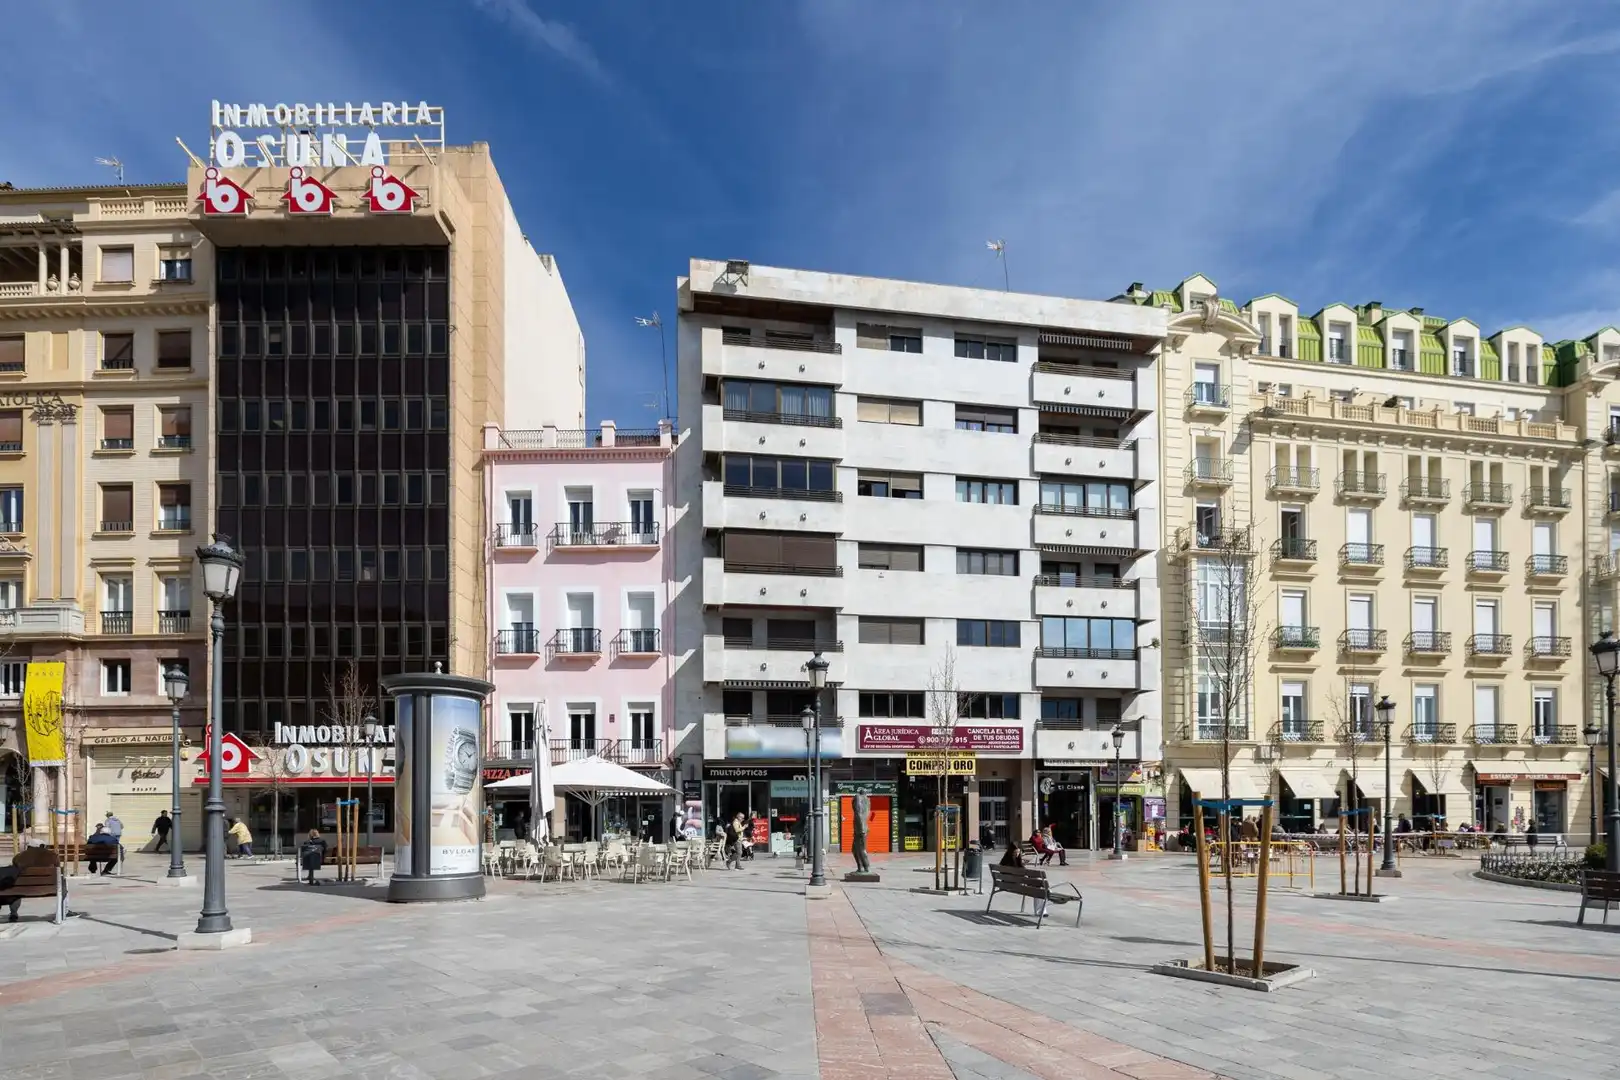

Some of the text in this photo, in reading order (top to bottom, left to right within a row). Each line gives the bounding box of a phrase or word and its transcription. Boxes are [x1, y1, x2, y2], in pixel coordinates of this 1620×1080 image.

[211, 99, 432, 127] INMOBILIARIA
[215, 130, 385, 168] OSUNA
[274, 721, 395, 743] INMOBILAR
[482, 769, 511, 779] PIZZA
[953, 760, 973, 770] ORO
